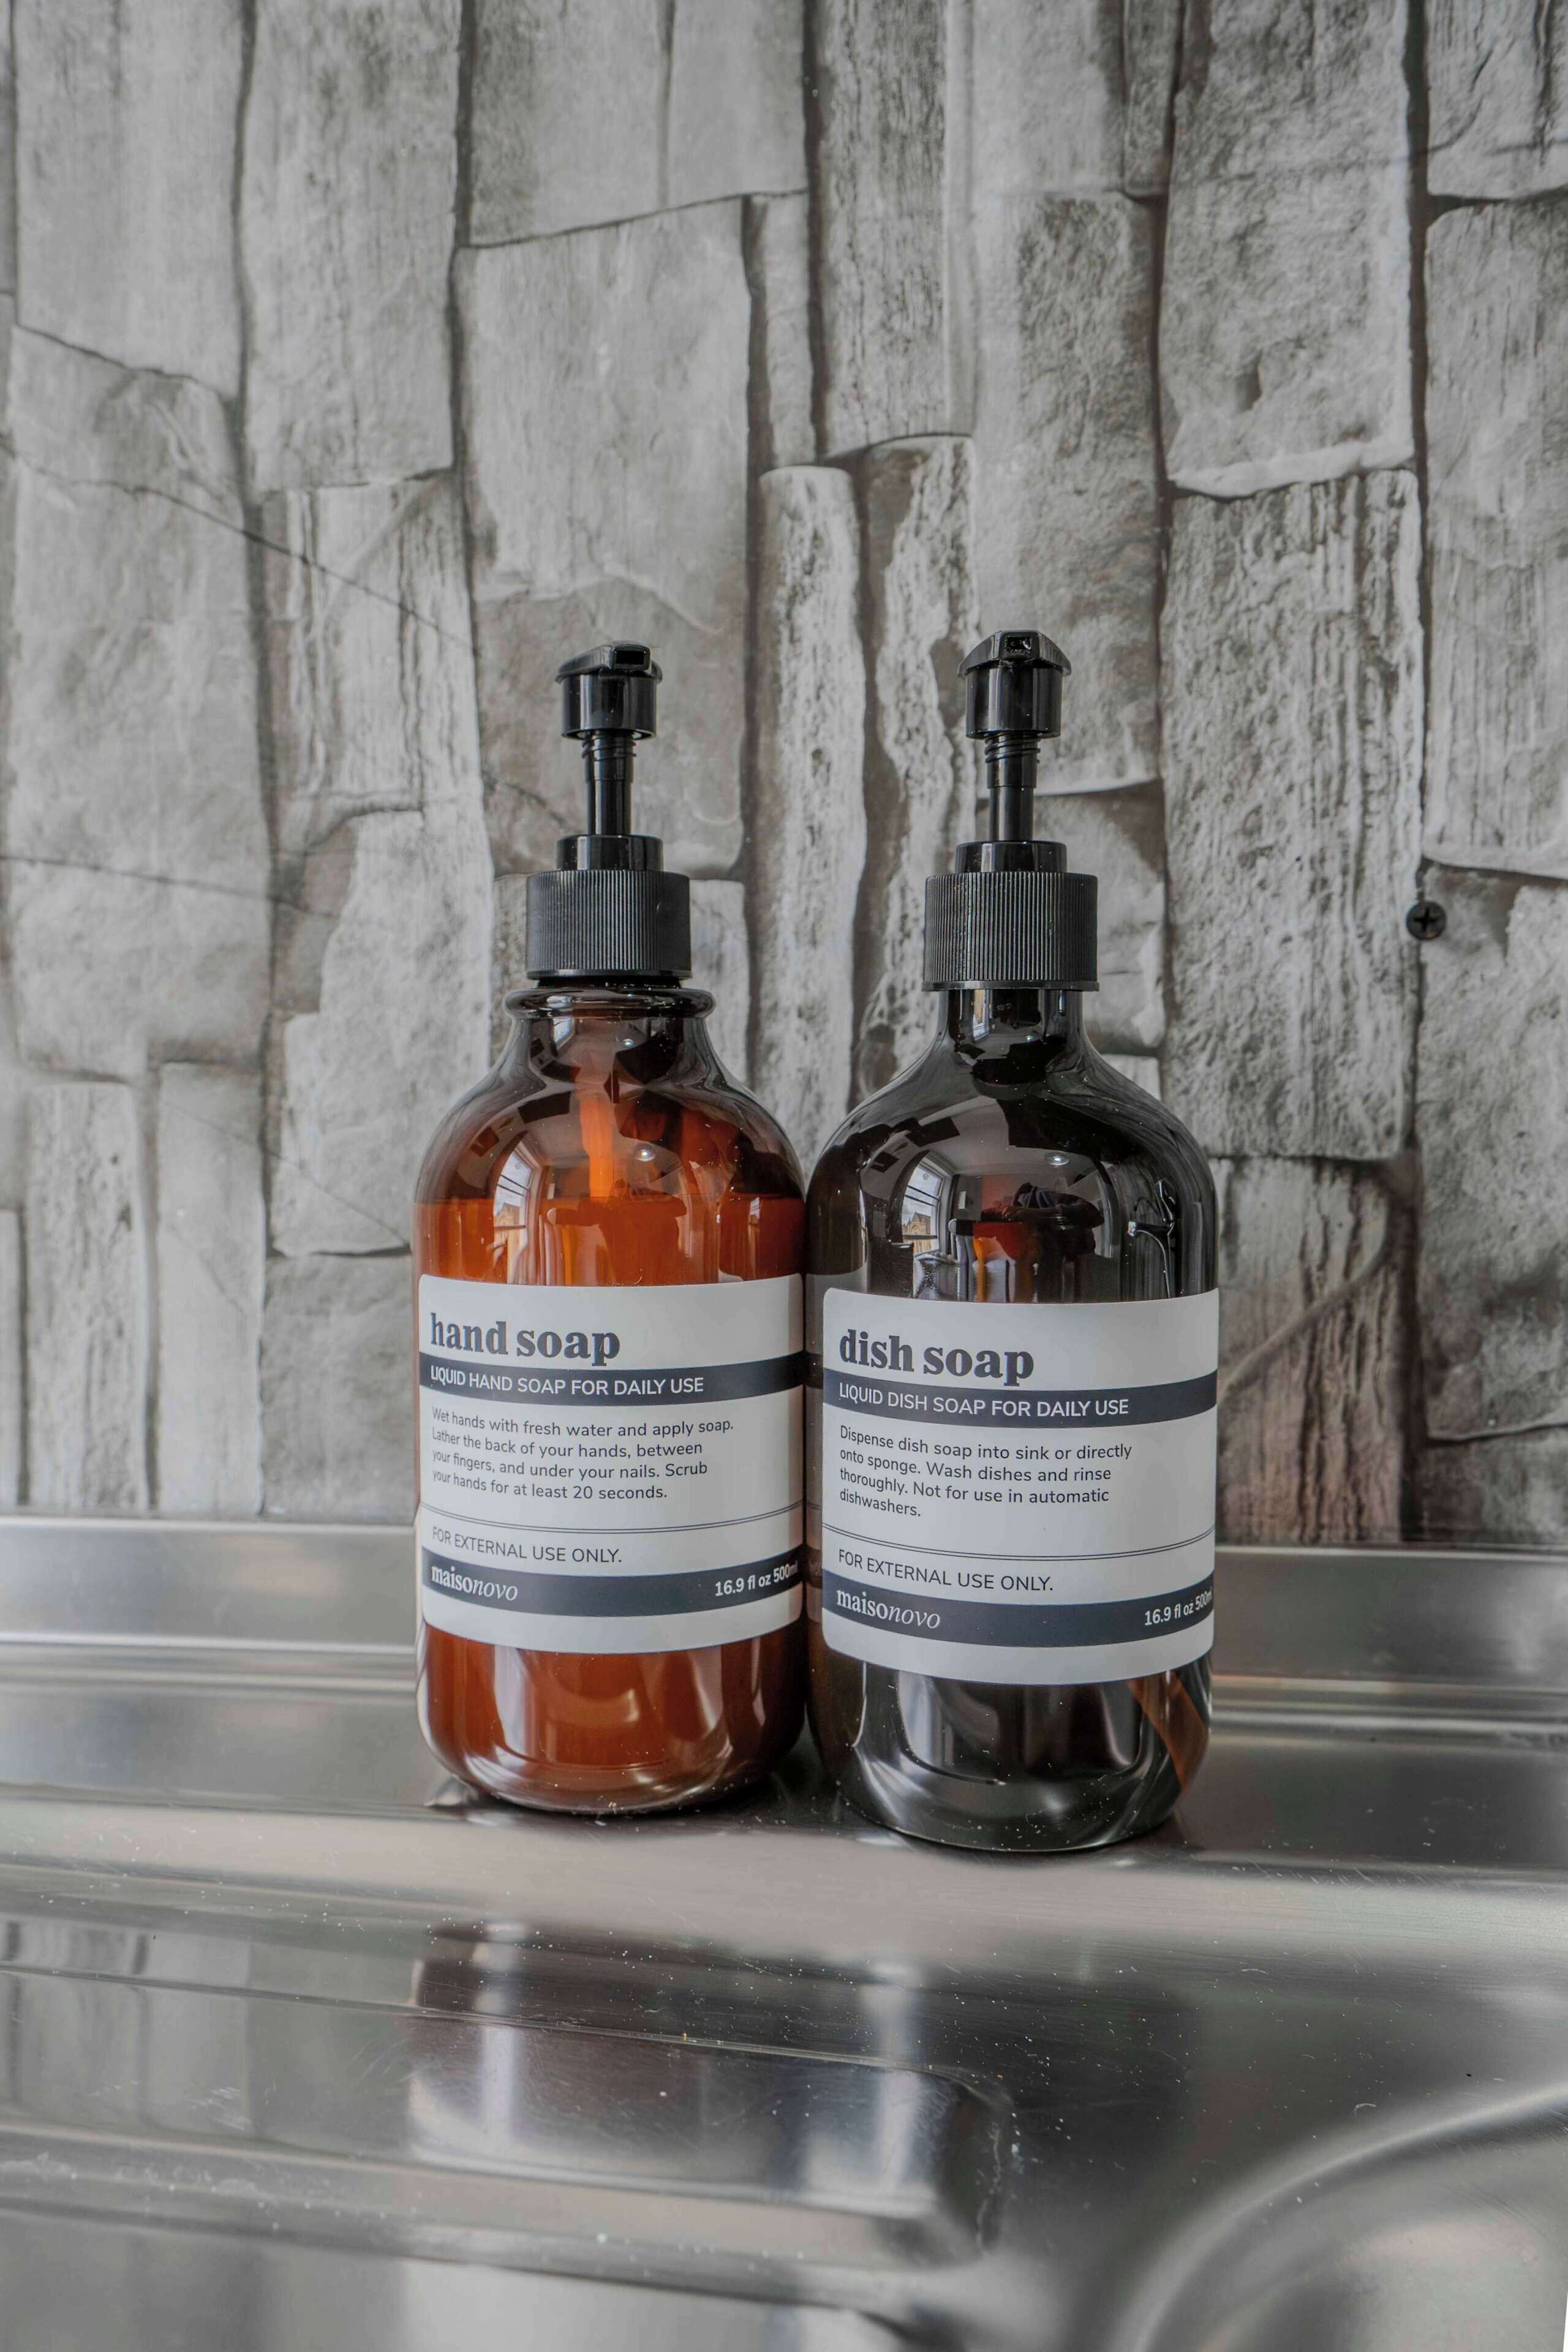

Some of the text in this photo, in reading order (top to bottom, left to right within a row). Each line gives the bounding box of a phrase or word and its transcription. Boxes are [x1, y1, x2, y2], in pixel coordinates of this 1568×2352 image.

[430, 1312, 620, 1367] hand soap
[839, 1329, 1035, 1387] dish soap
[431, 1365, 704, 1395] LIQUID HAND SOAP FOR DAILY USE
[839, 1382, 1129, 1417] LIQUID DISH SOAP FOR DAILY USE
[432, 1406, 734, 1439] Wet hands with fresh water and apply soap.
[432, 1425, 703, 1460] Lather the back of your hands, between
[840, 1425, 1133, 1460] Dispense dish soap into sink or directly
[432, 1450, 707, 1482] your fingers, and under your nails. Scrub
[840, 1449, 1111, 1482] onto sponge. Wash dishes and rinse
[432, 1469, 667, 1499] your hands for at least 20 seconds.
[840, 1468, 1109, 1504] thoroughly. Not for use in automatic
[840, 1488, 921, 1517] dishwashers.
[432, 1526, 622, 1563] FOR EXTERNAL USE ONLY.
[431, 1564, 518, 1601] maisonovo
[715, 1577, 745, 1597] 16.9
[747, 1574, 756, 1590] fl
[758, 1574, 771, 1588] oz
[839, 1548, 1054, 1591] FOR EXTERNAL USE ONLY.
[836, 1589, 940, 1629] maisonovo
[1144, 1606, 1172, 1626] 16.9
[1174, 1603, 1181, 1619] fl
[1183, 1602, 1194, 1616] oz
